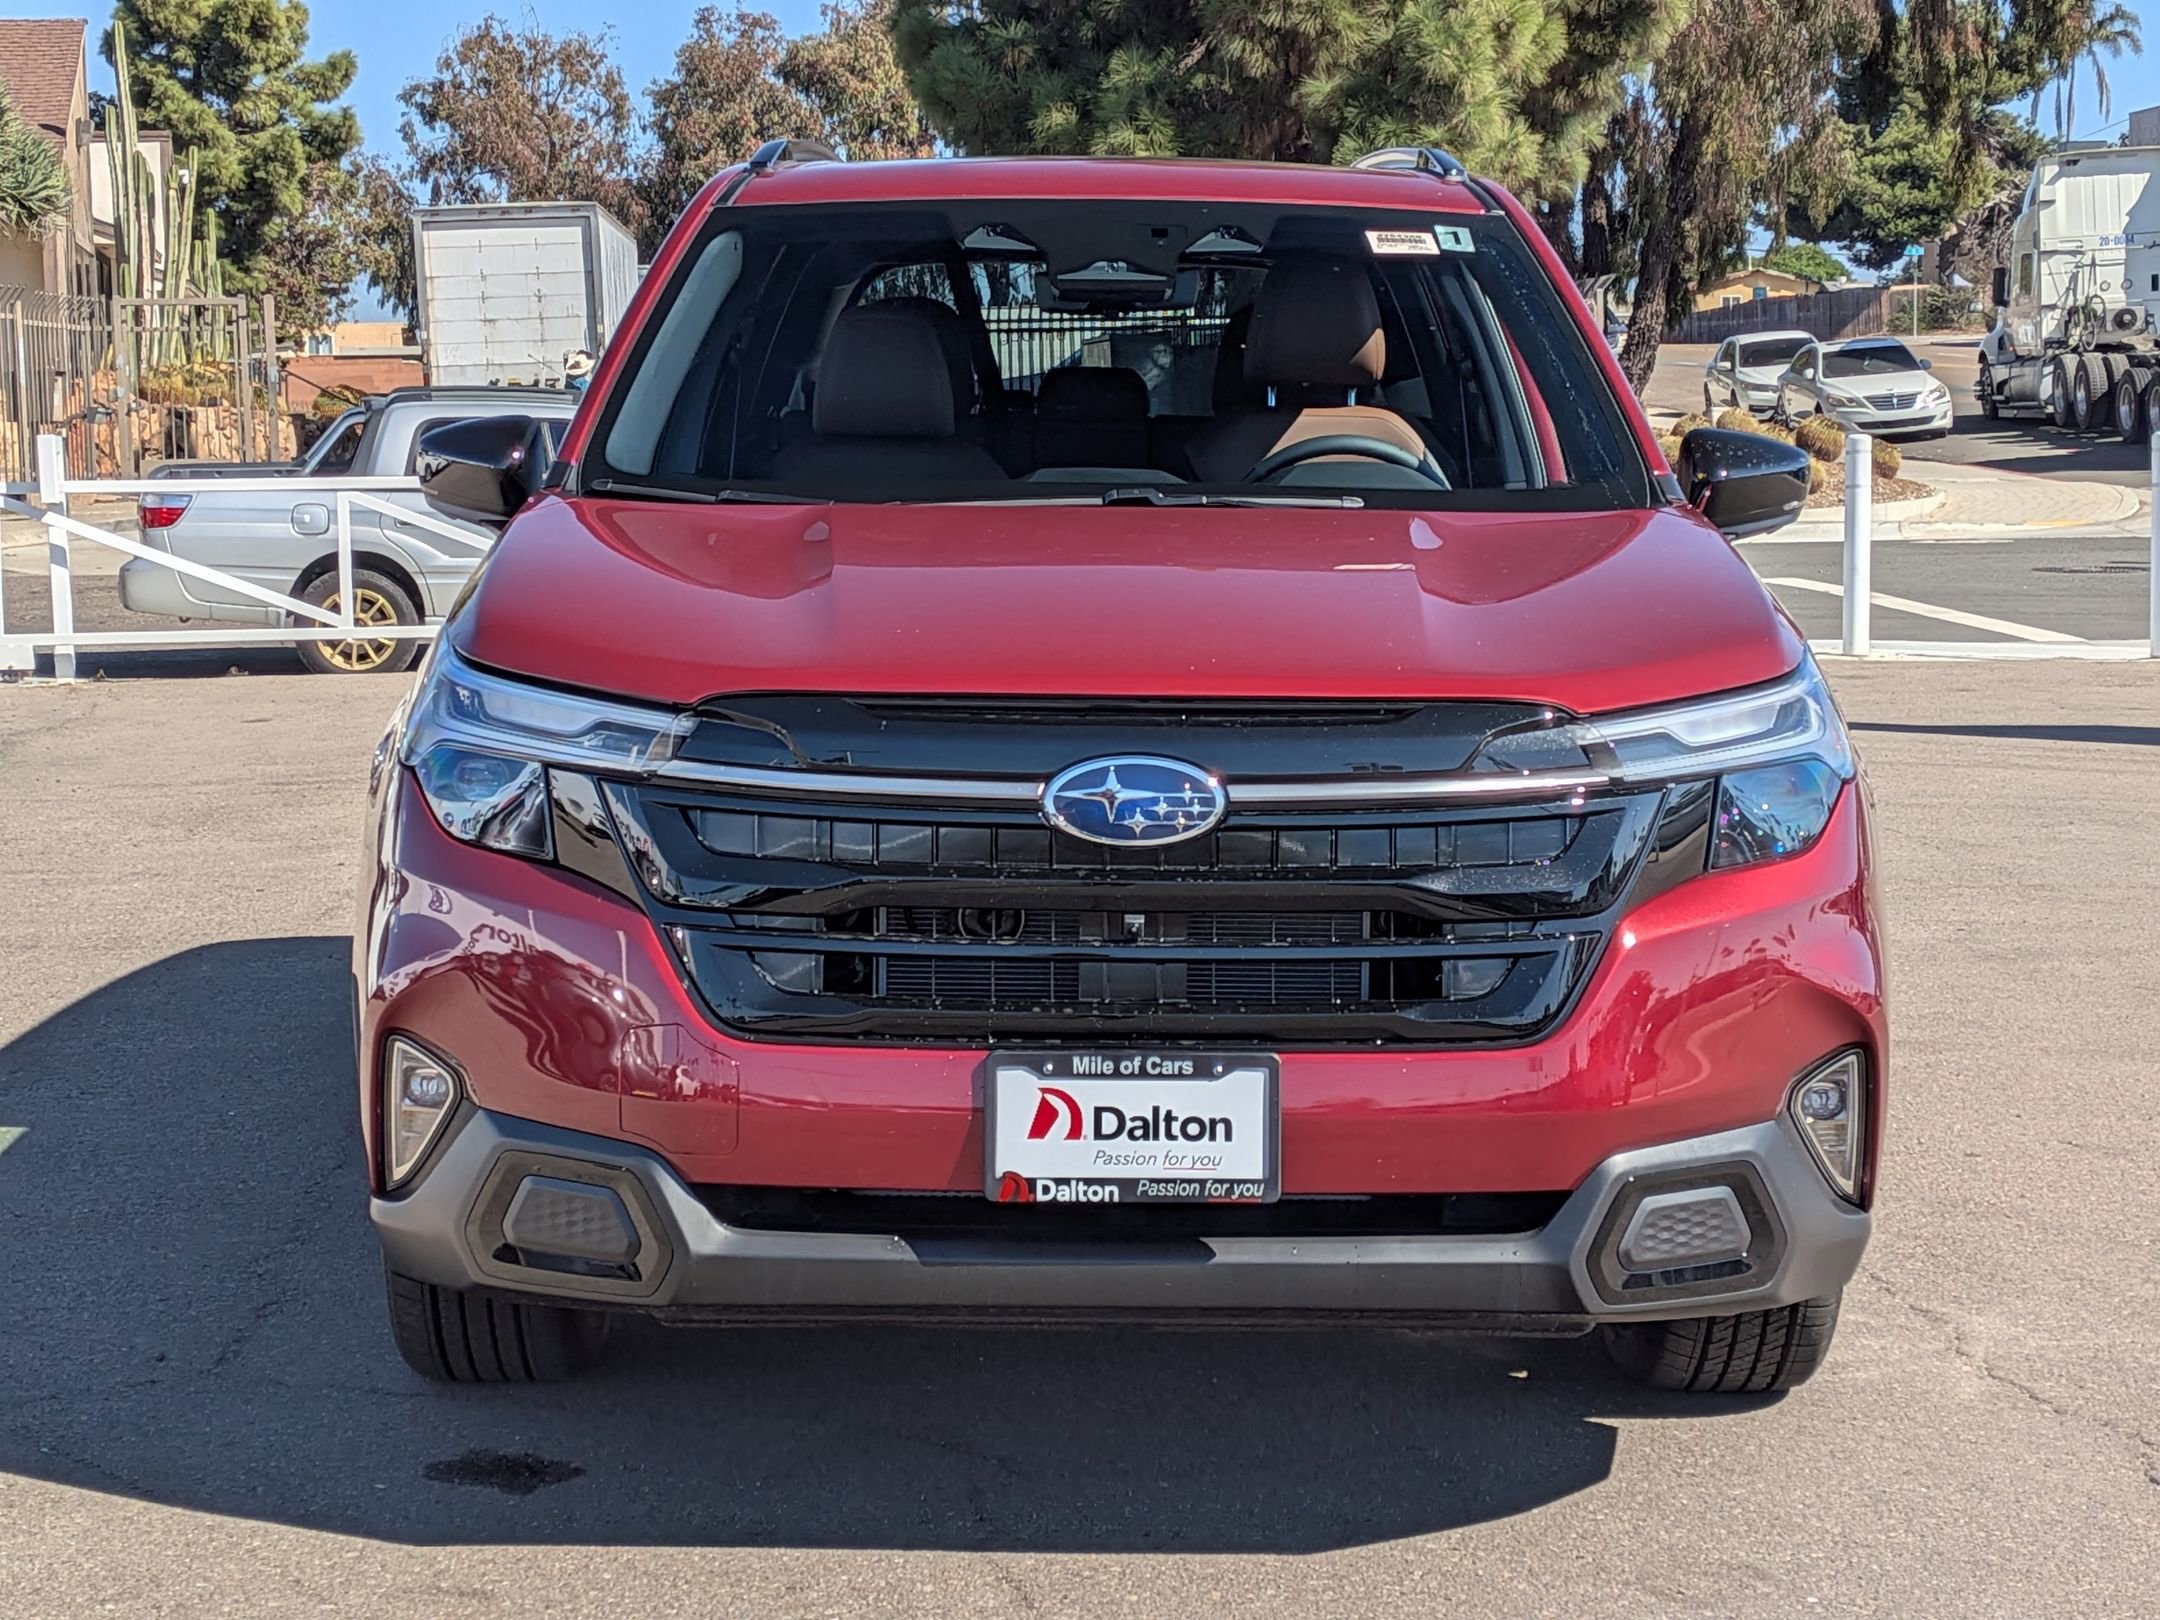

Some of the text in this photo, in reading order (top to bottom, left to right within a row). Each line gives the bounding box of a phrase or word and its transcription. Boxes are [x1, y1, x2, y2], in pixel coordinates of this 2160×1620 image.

[1072, 1056, 1194, 1075] Mile of Cars
[1093, 1105, 1233, 1142] Dalton
[1093, 1150, 1222, 1169] Passion for you
[1036, 1179, 1120, 1203] Dalton
[1136, 1179, 1265, 1200] Passion for you
